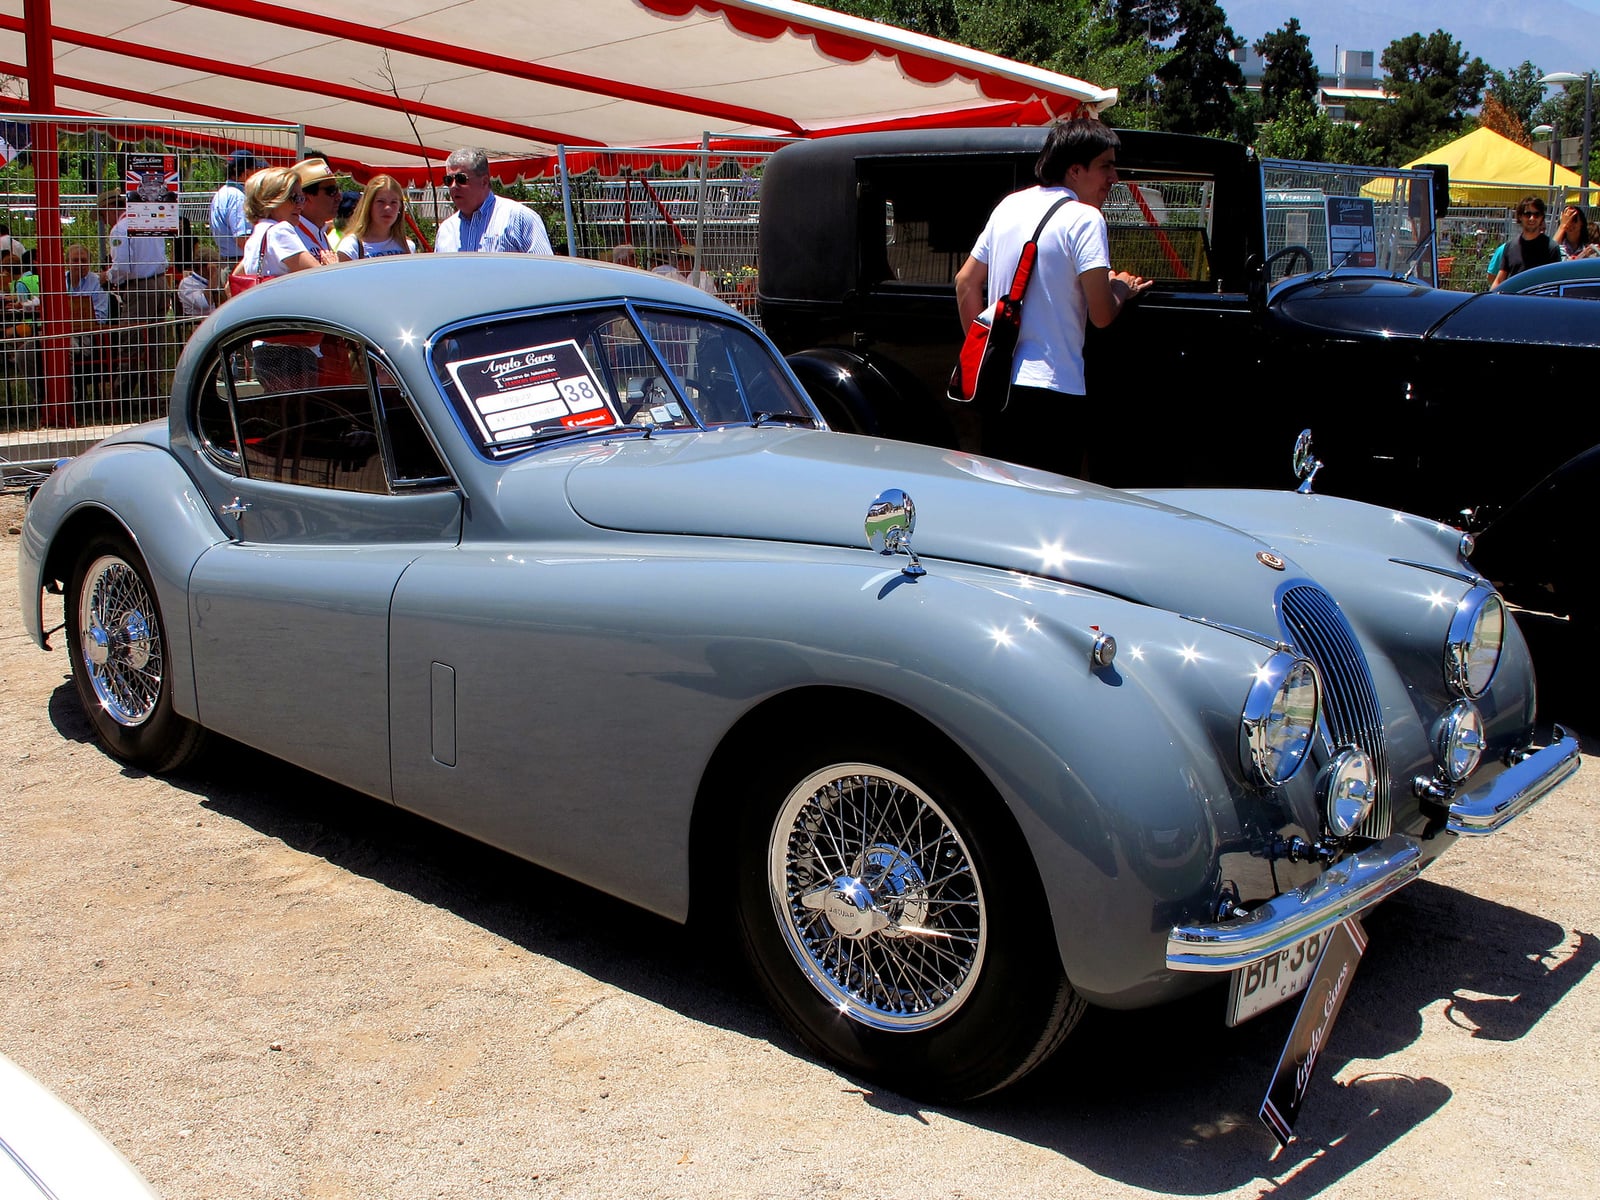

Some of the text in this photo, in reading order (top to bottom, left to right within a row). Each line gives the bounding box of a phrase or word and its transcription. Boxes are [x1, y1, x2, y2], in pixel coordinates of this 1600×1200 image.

[1362, 230, 1373, 244] 64
[481, 353, 556, 375] Anglo Cars
[563, 381, 594, 402] 38
[829, 906, 855, 918] JAGUAR
